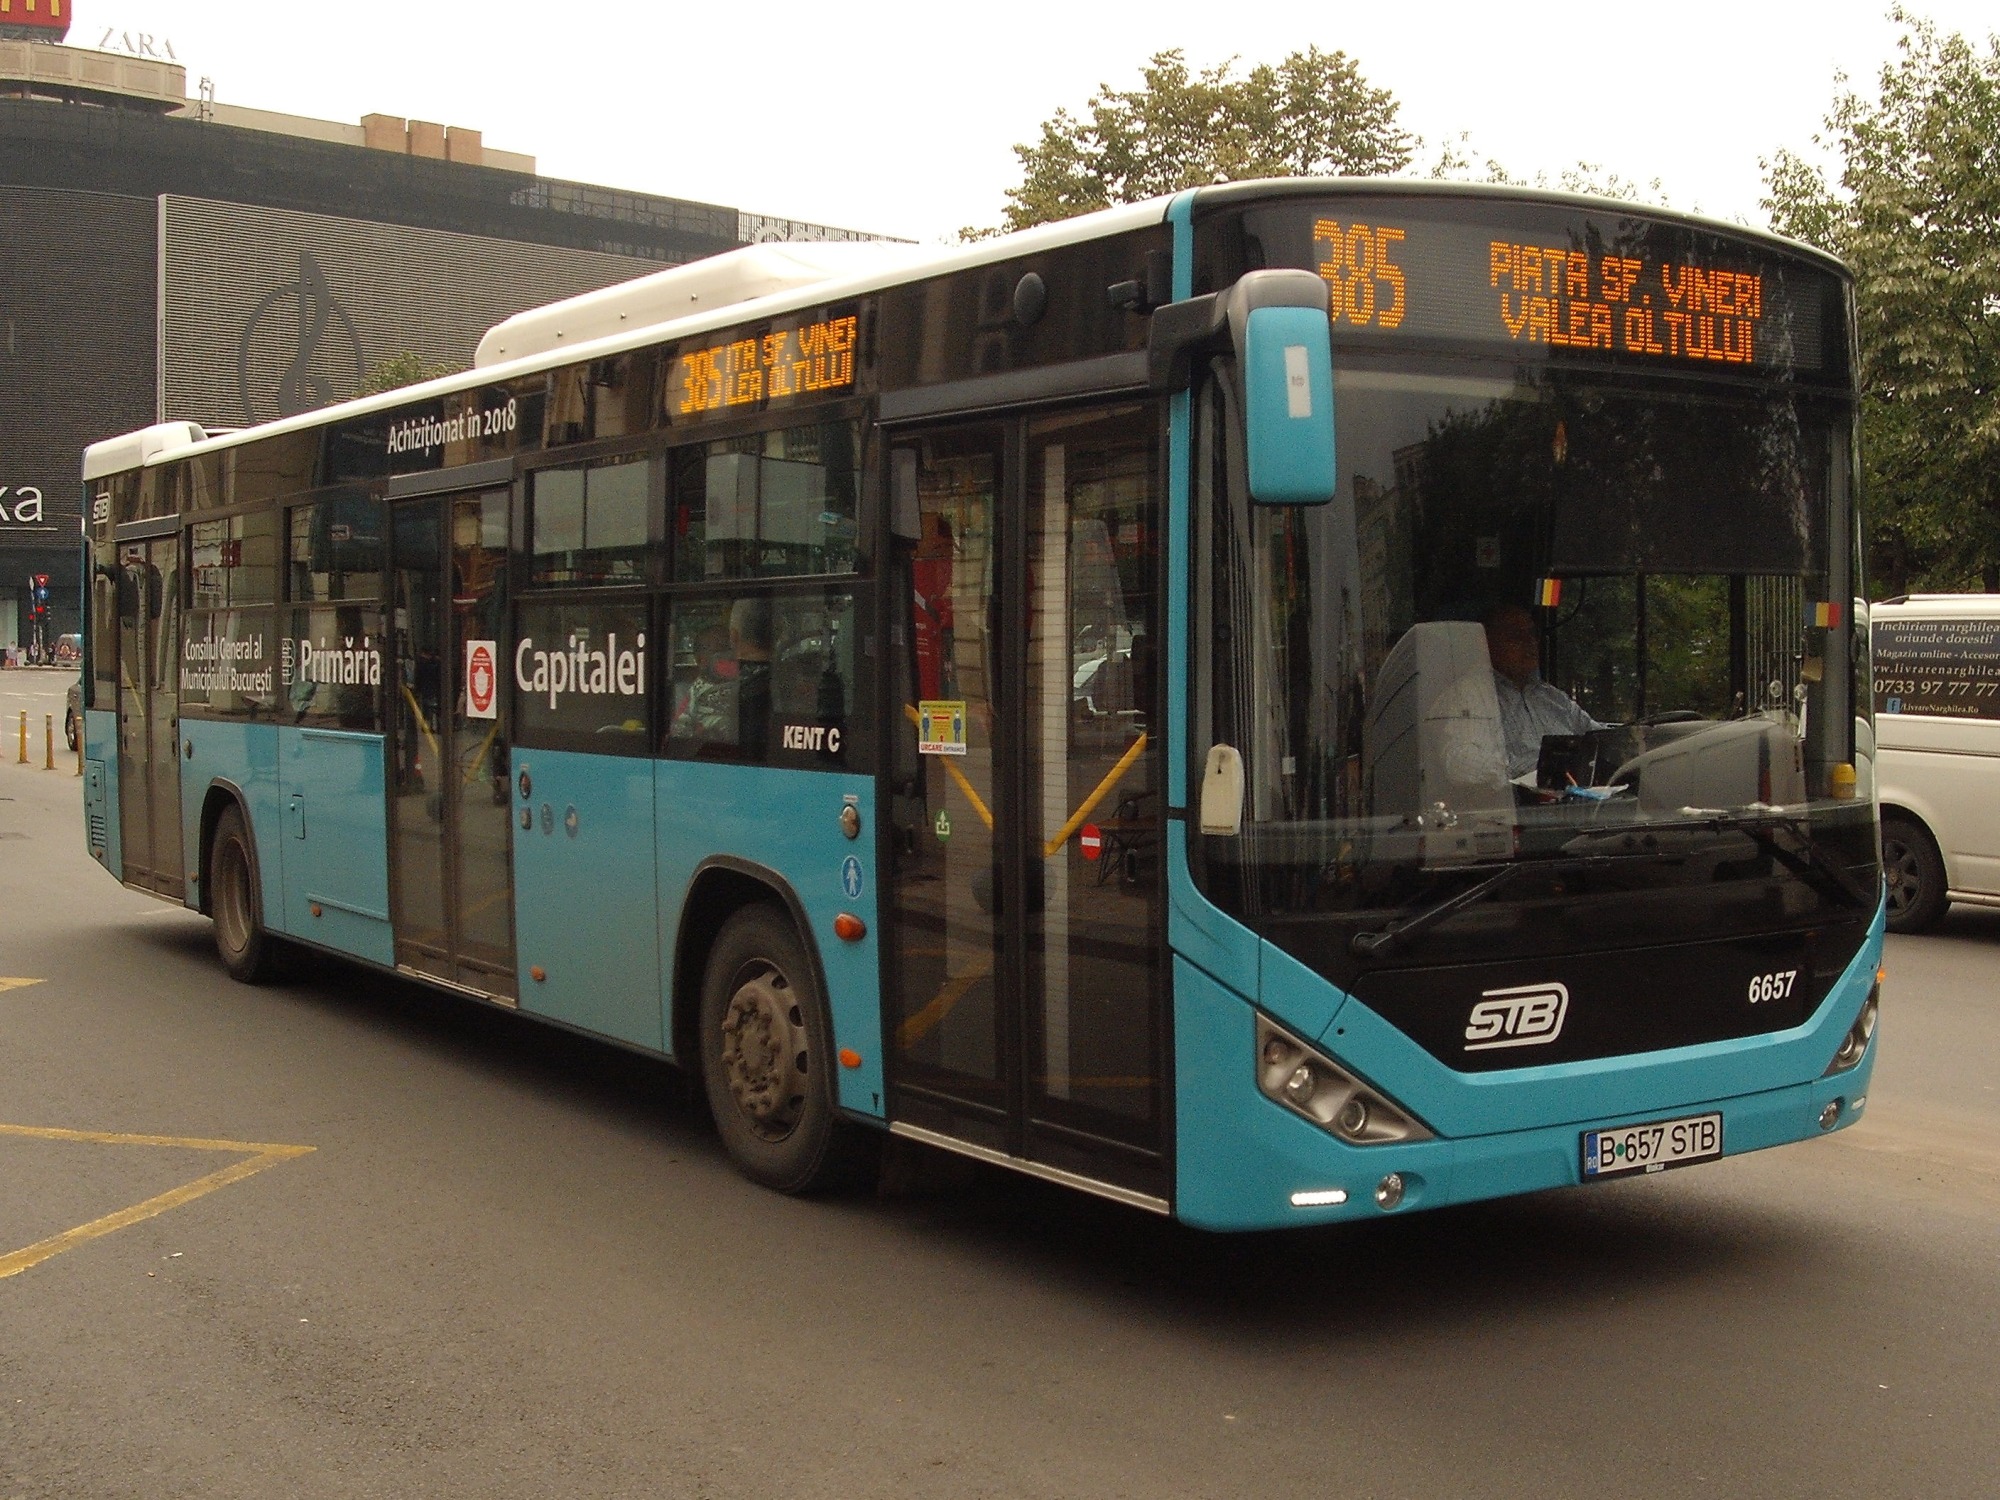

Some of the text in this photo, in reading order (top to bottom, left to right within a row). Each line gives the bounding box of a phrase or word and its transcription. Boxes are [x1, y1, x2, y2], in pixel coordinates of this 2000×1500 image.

[99, 27, 177, 60] ZARA
[1314, 219, 1405, 328] 385
[1490, 241, 1761, 318] PIATA SF. VINERI
[1502, 292, 1754, 363] VALEA OLTULUI
[680, 346, 723, 414] 385
[387, 398, 516, 457] Achiziționat în 2018
[1880, 621, 1937, 632] Inchiriem
[1895, 633, 1994, 644] oriunde doresti!
[185, 633, 262, 660] Consiliul General al
[301, 637, 381, 685] Primăria
[1876, 649, 1918, 659] Magazin
[1920, 649, 1952, 659] online
[181, 667, 229, 697] Municipiului
[516, 633, 645, 709] Capitalei
[1874, 680, 1999, 697] 0733 97 77 77
[783, 725, 841, 753] KENT C
[1749, 971, 1797, 1003] 6657
[1465, 994, 1559, 1040] STB
[1601, 1120, 1716, 1167] B 657 STB
